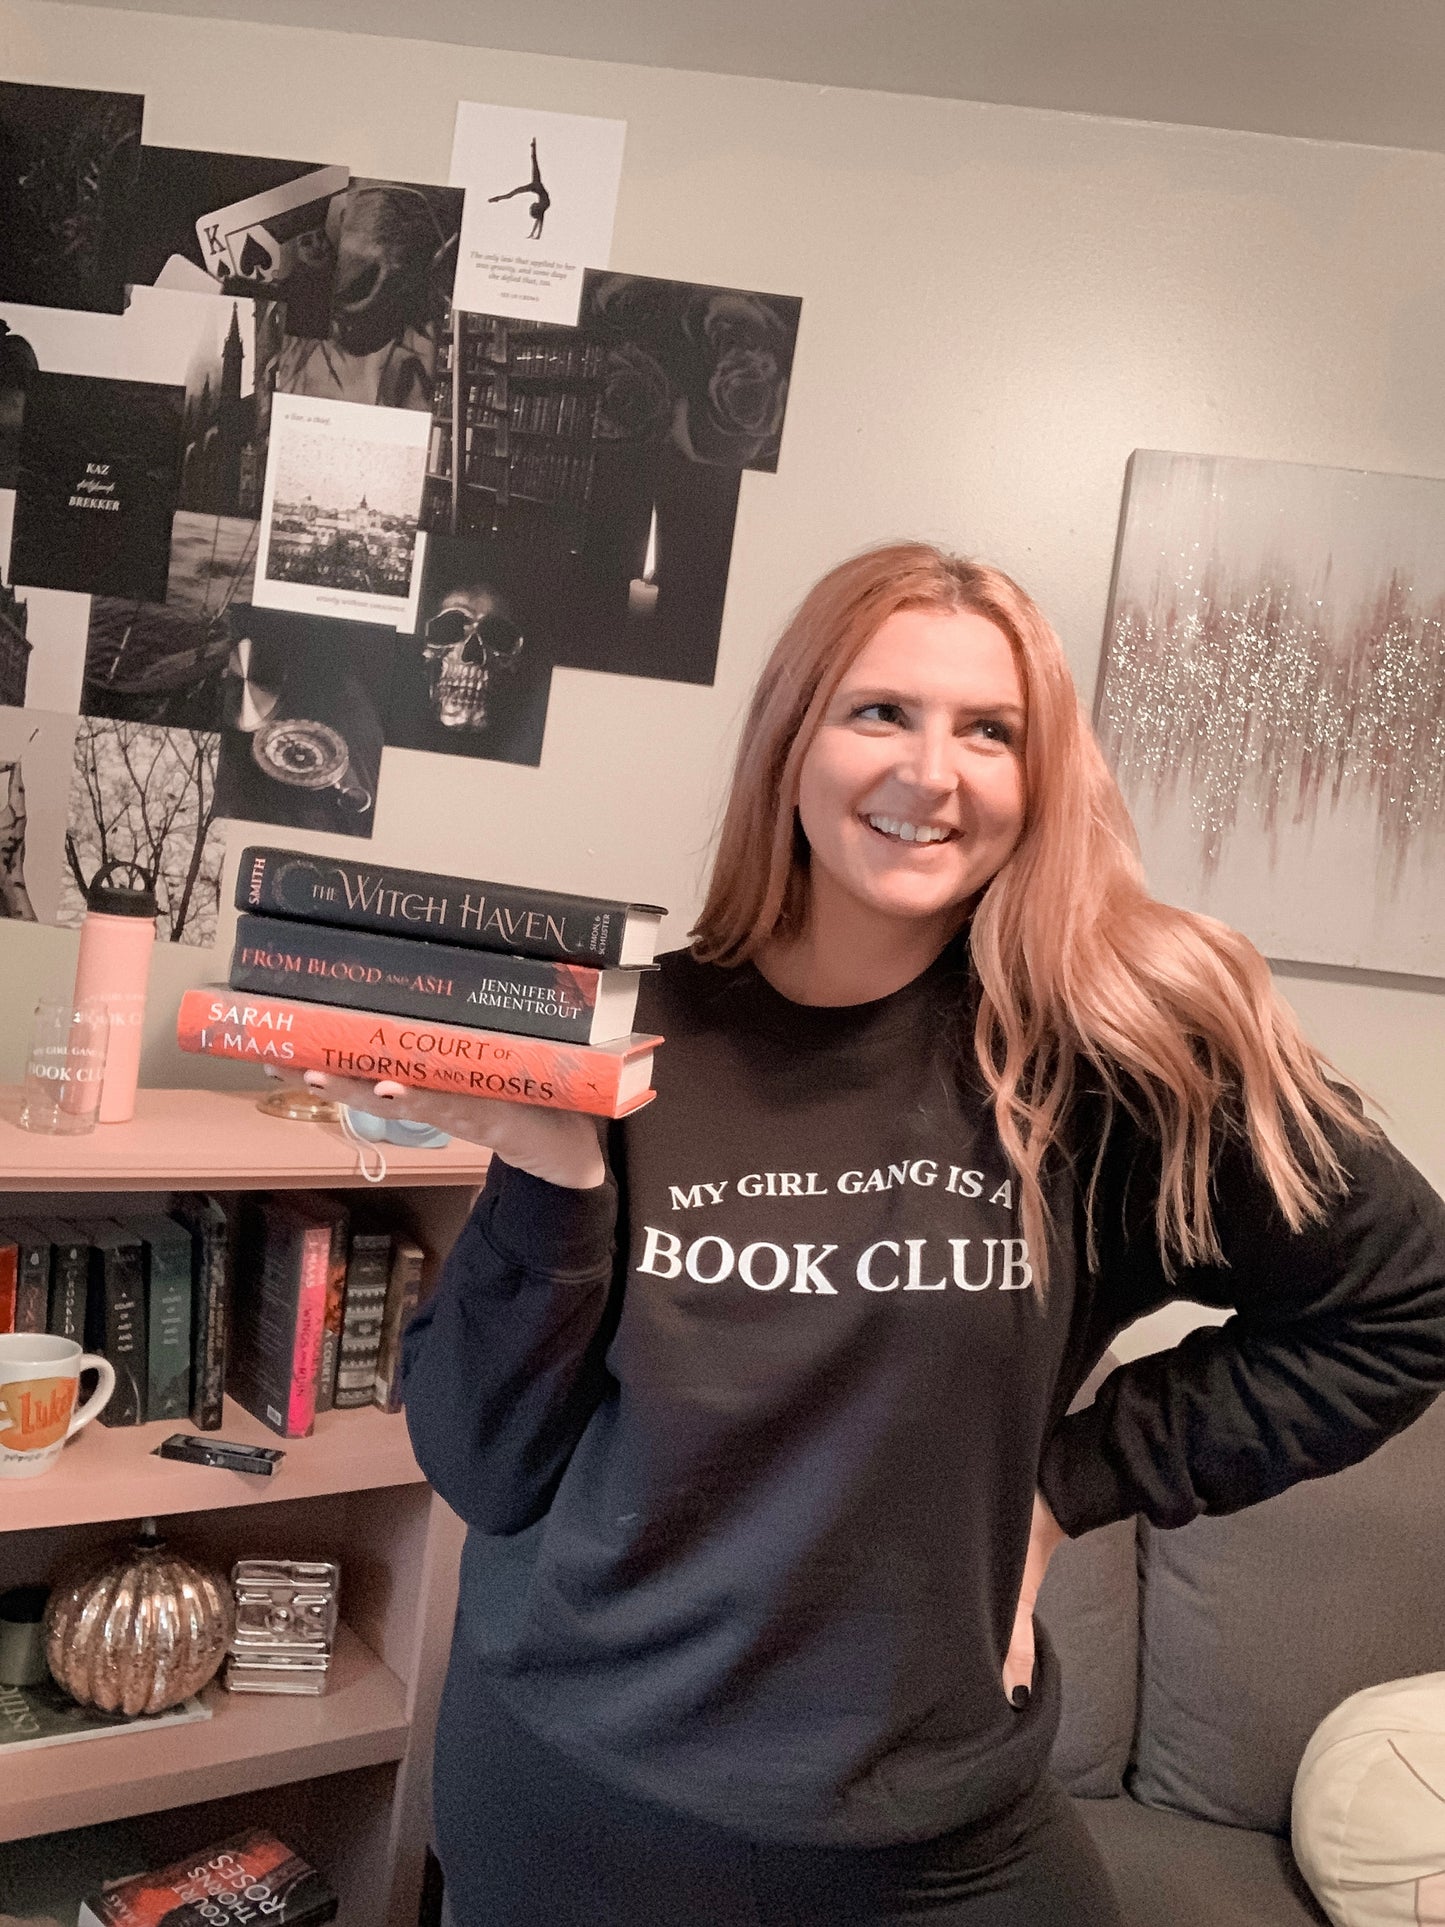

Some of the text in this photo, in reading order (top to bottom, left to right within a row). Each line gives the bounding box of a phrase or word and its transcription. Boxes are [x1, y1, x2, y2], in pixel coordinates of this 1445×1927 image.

[203, 224, 226, 255] K
[86, 463, 110, 475] KAZ
[68, 496, 120, 511] BREKKER
[248, 858, 266, 905] SMITH
[313, 869, 574, 953] THE WITCH HAVEN
[589, 923, 600, 951] SIMON
[598, 913, 611, 955] SCHUSTER
[241, 947, 453, 997] FROM BLOOD AND ASH
[480, 978, 556, 1003] JENNIFER
[207, 1002, 294, 1032] SARAH
[466, 991, 582, 1020] ARMENTROUT
[223, 1032, 295, 1060] MAAS
[369, 1027, 514, 1061] A COURT OF
[321, 1047, 554, 1100] THORNS AND ROSES
[668, 1159, 1013, 1210] MY GIRL GANG IS A
[636, 1226, 1033, 1295] BOOK CLUB
[300, 1308, 312, 1348] WINGS
[325, 1328, 334, 1339] A
[321, 1341, 334, 1382] COURT
[187, 1866, 257, 1925] THORNS
[208, 1854, 287, 1915] ROSES
[170, 1883, 230, 1927] COURT
